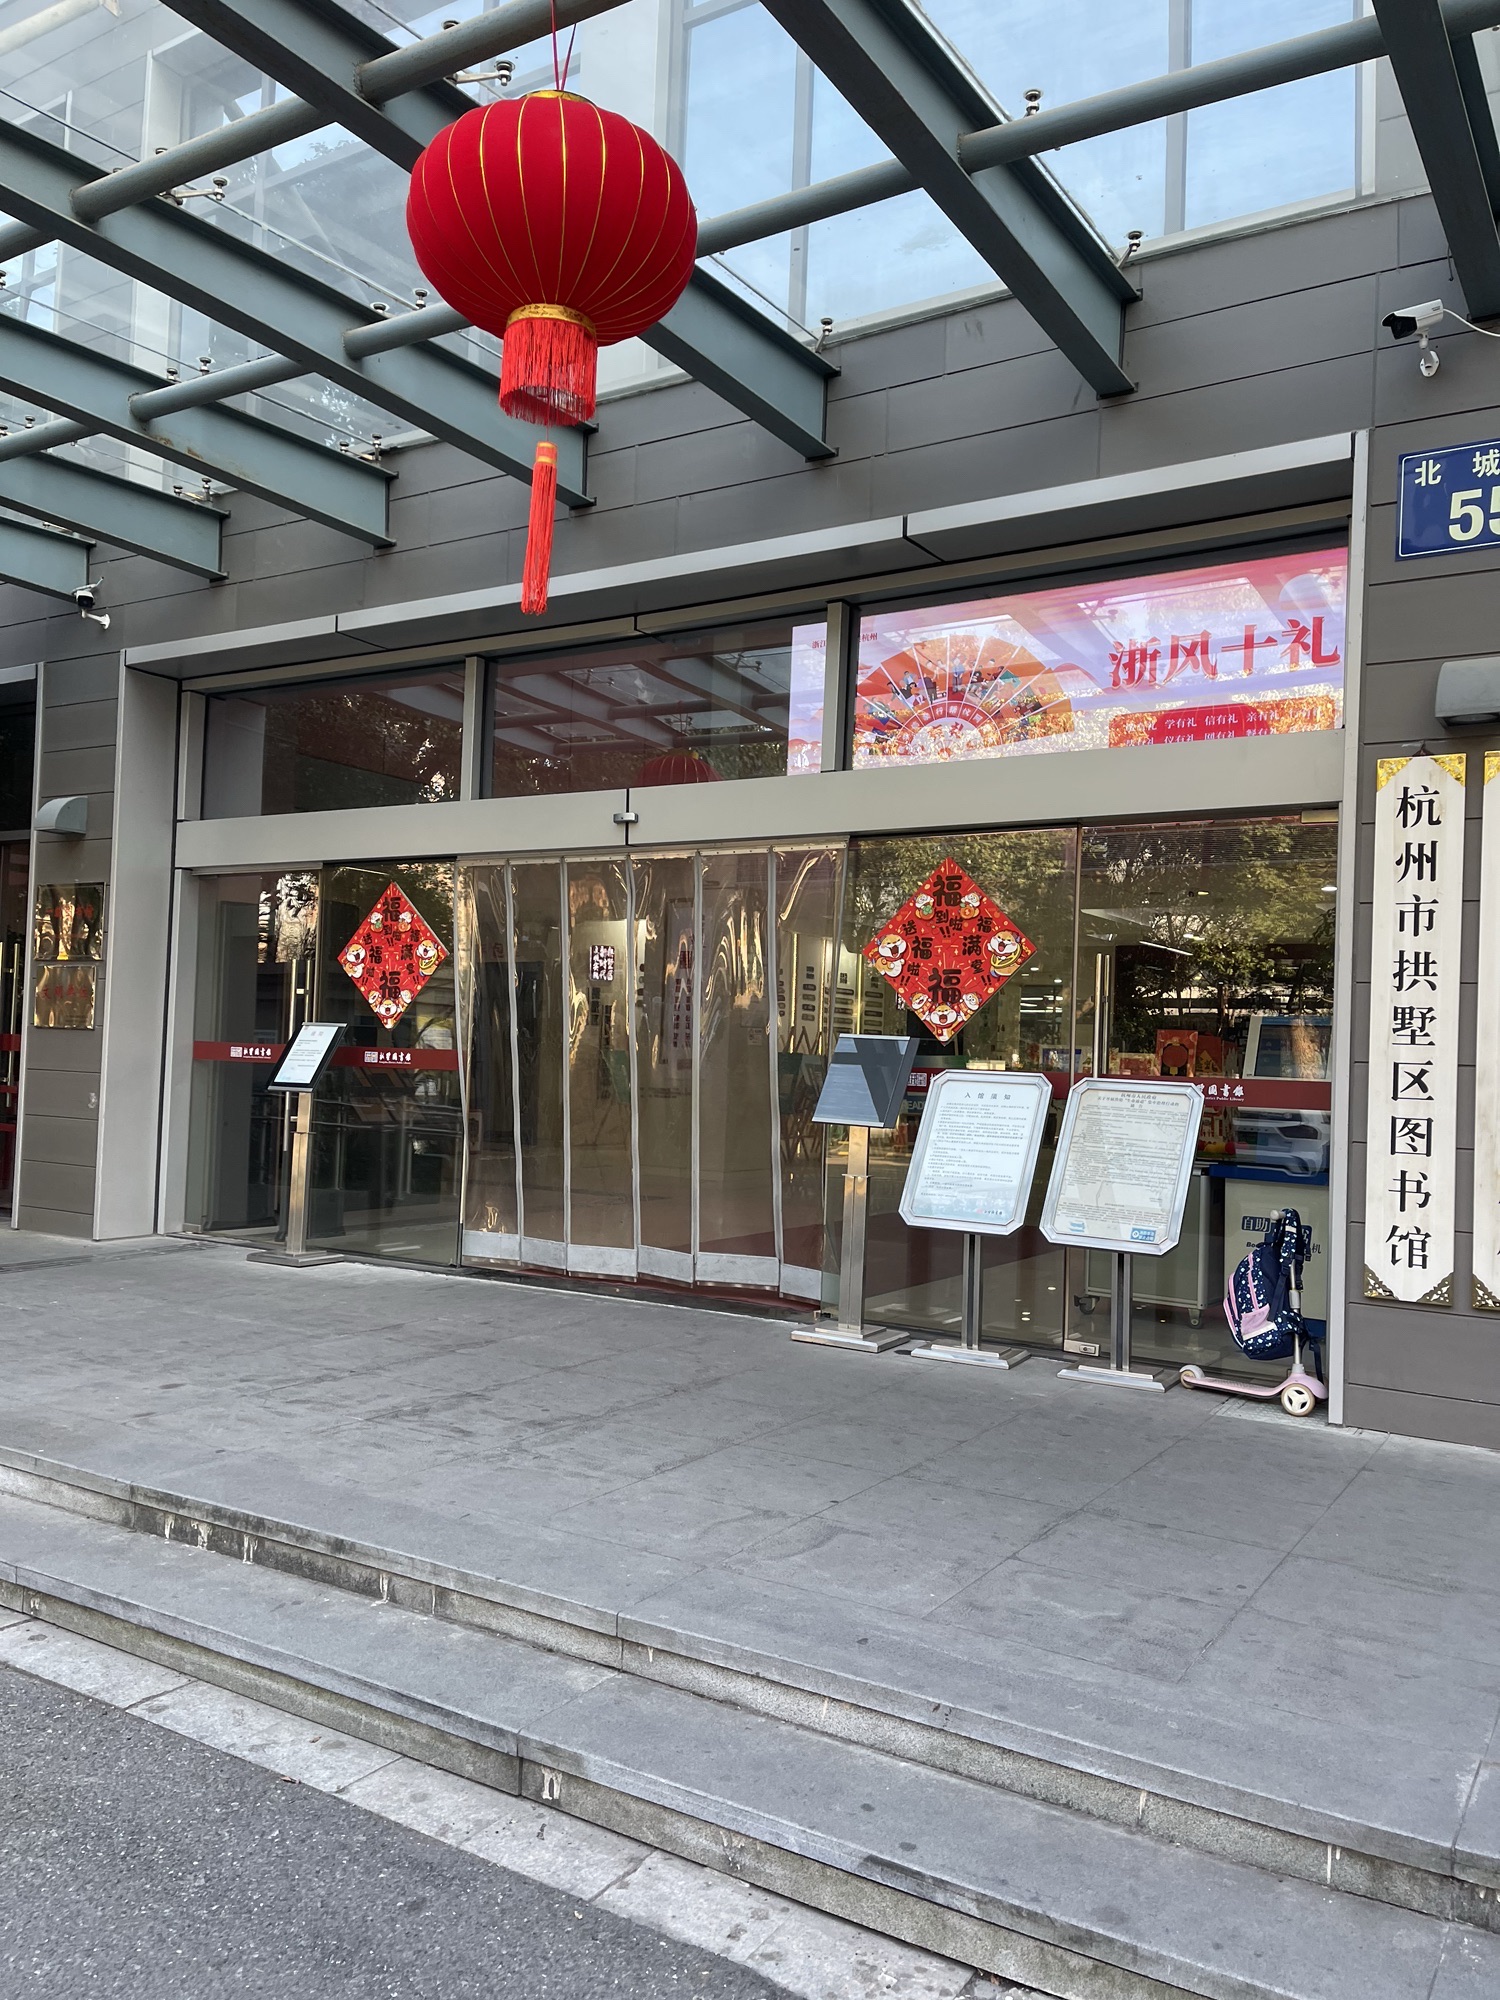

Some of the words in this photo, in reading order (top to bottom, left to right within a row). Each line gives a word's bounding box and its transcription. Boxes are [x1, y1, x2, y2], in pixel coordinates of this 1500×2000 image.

[859, 632, 878, 643] 杭州
[1109, 616, 1341, 689] 浙风十礼
[1164, 717, 1198, 729] 学有礼
[1205, 713, 1238, 726] 信有礼
[933, 875, 963, 907] 福
[382, 896, 401, 922] 福
[379, 970, 401, 999] 福
[929, 967, 963, 1004] 福
[1385, 785, 1442, 1270] 杭州市拱墅区图书馆
[1243, 1216, 1269, 1232] 自助
[1311, 1242, 1322, 1254] 机
